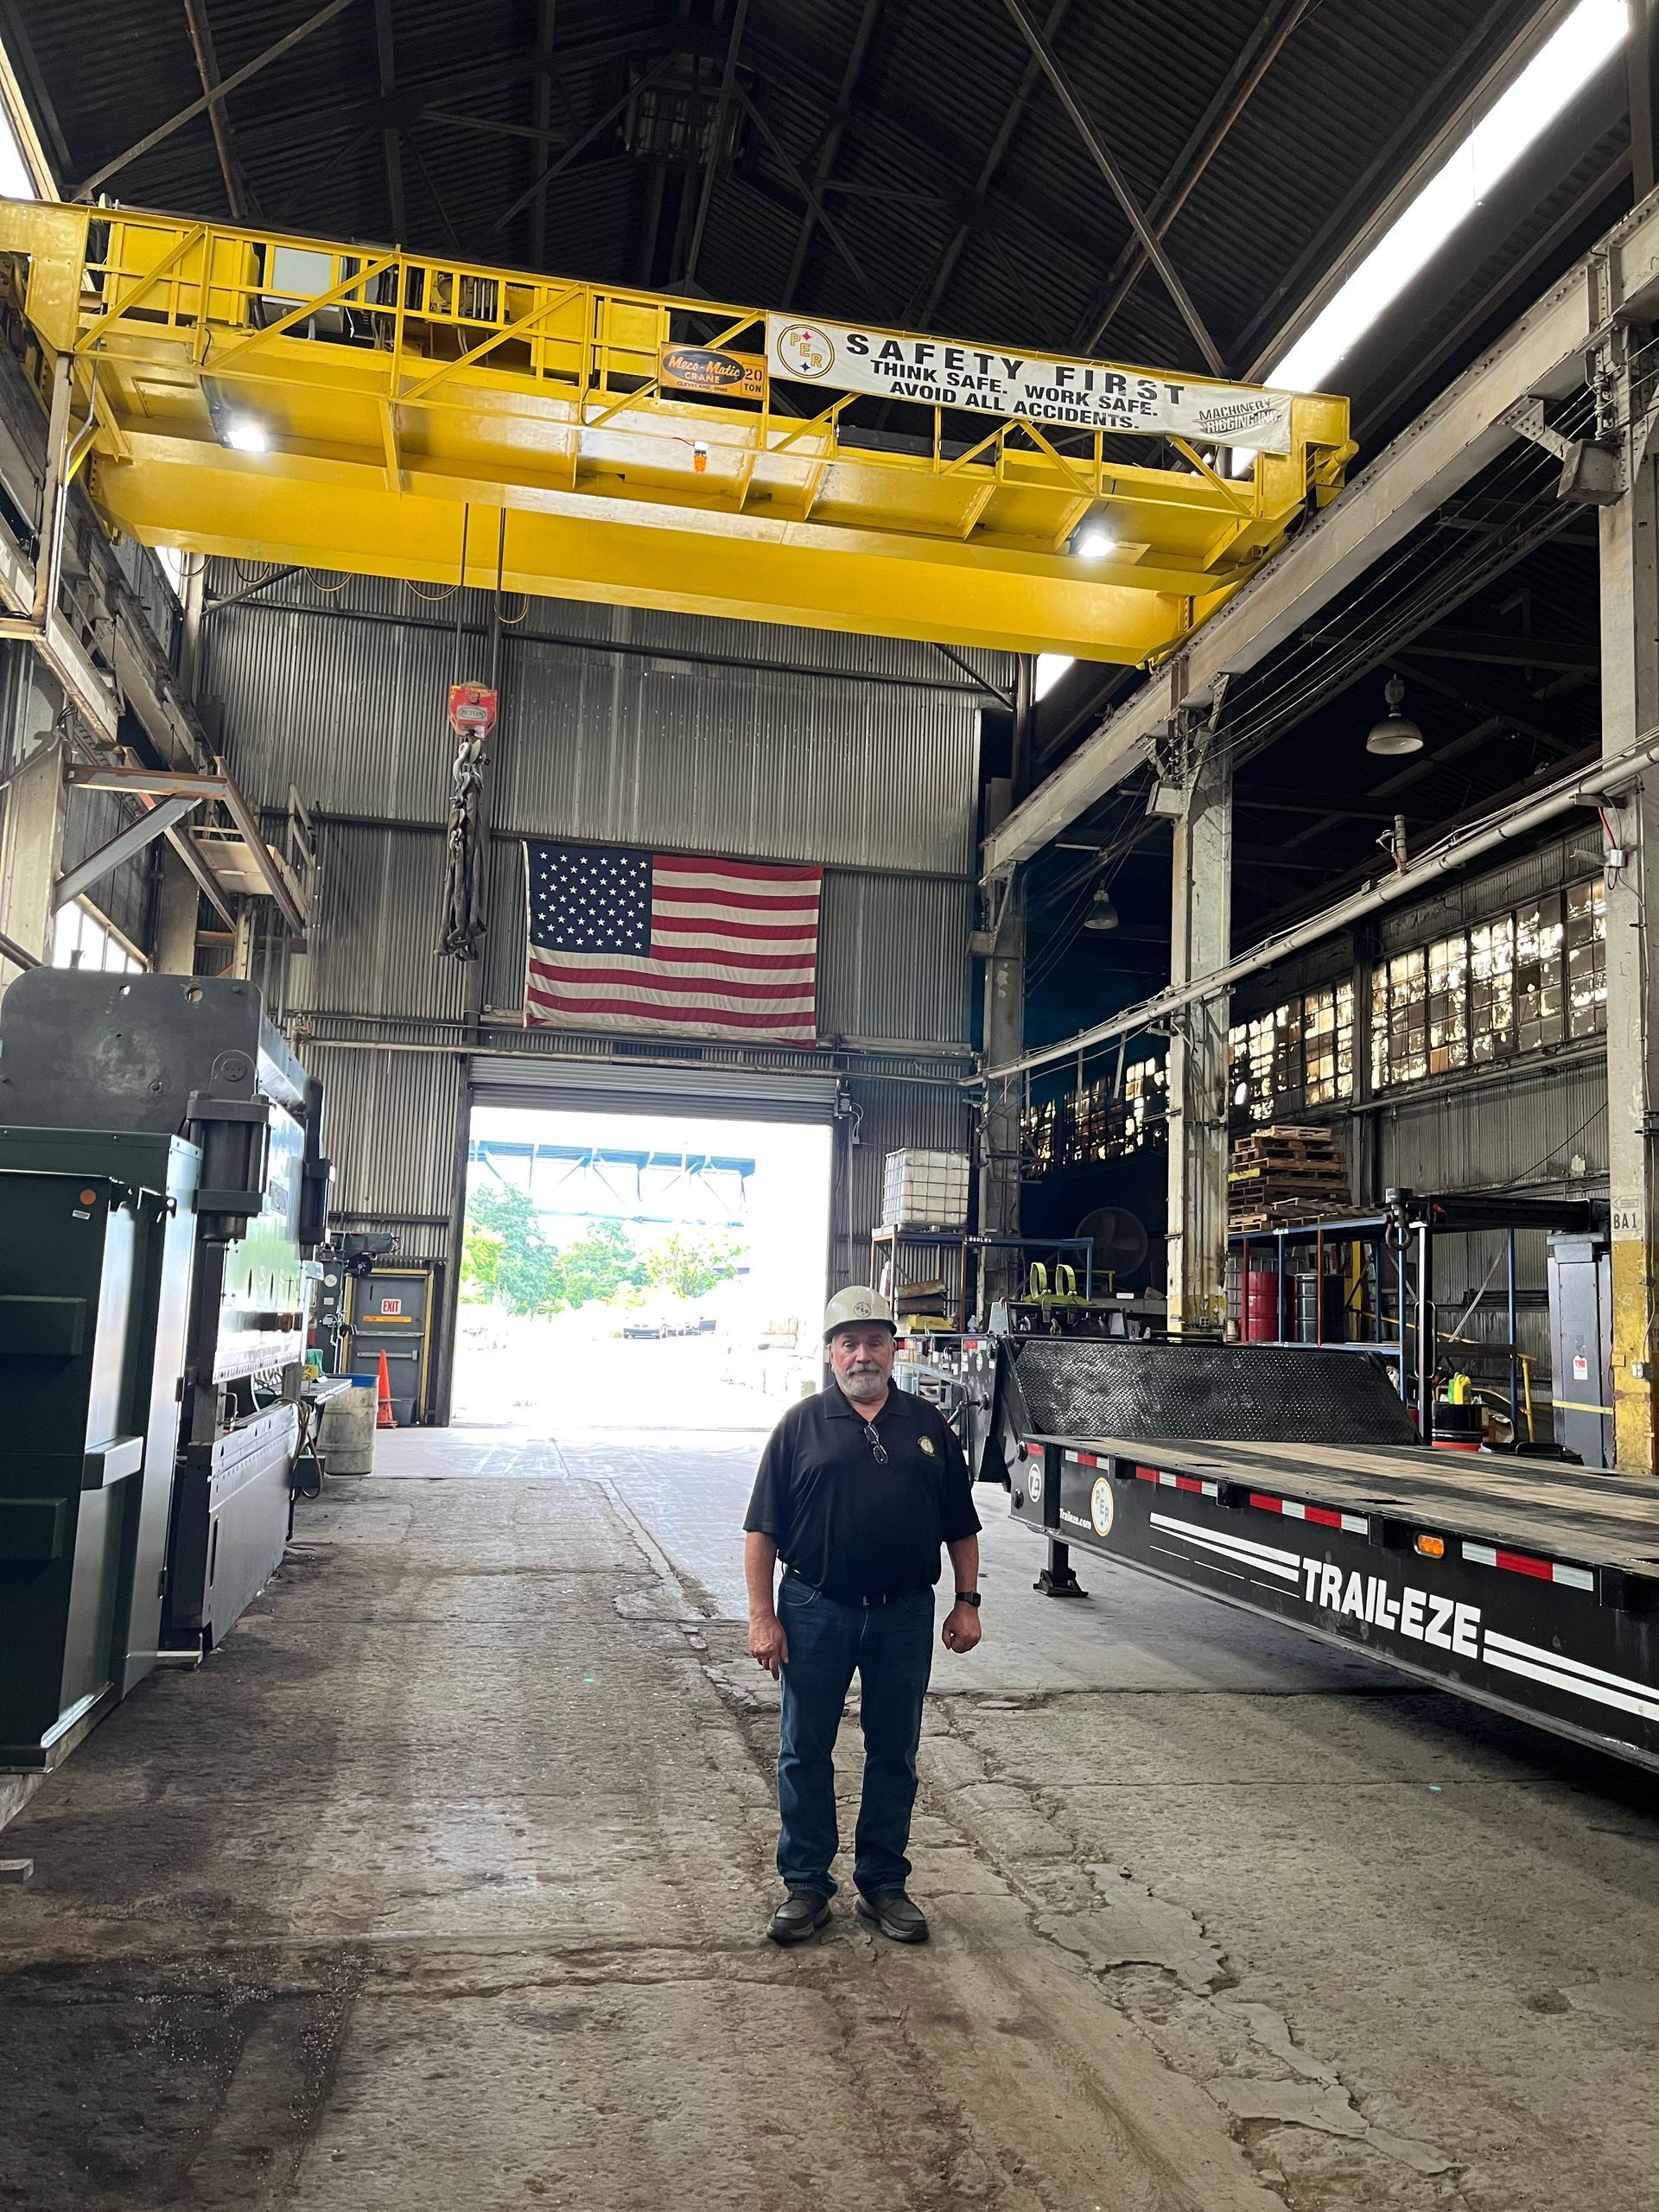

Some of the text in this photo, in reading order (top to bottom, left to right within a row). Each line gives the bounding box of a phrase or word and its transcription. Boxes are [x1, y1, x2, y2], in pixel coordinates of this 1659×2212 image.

[684, 371, 721, 385] CRANE
[744, 368, 763, 382] 20
[846, 334, 1185, 405] SAFETY FIRST
[743, 383, 762, 393] TON
[870, 359, 1158, 416] THINK SAFE. WORK SAFE.
[889, 381, 1140, 429] AVOID ALL ACCIDENTS.
[1198, 398, 1271, 421] MACHINERY
[383, 1300, 400, 1313] EXIT
[1302, 1557, 1482, 1660] TRAIL-EZE
